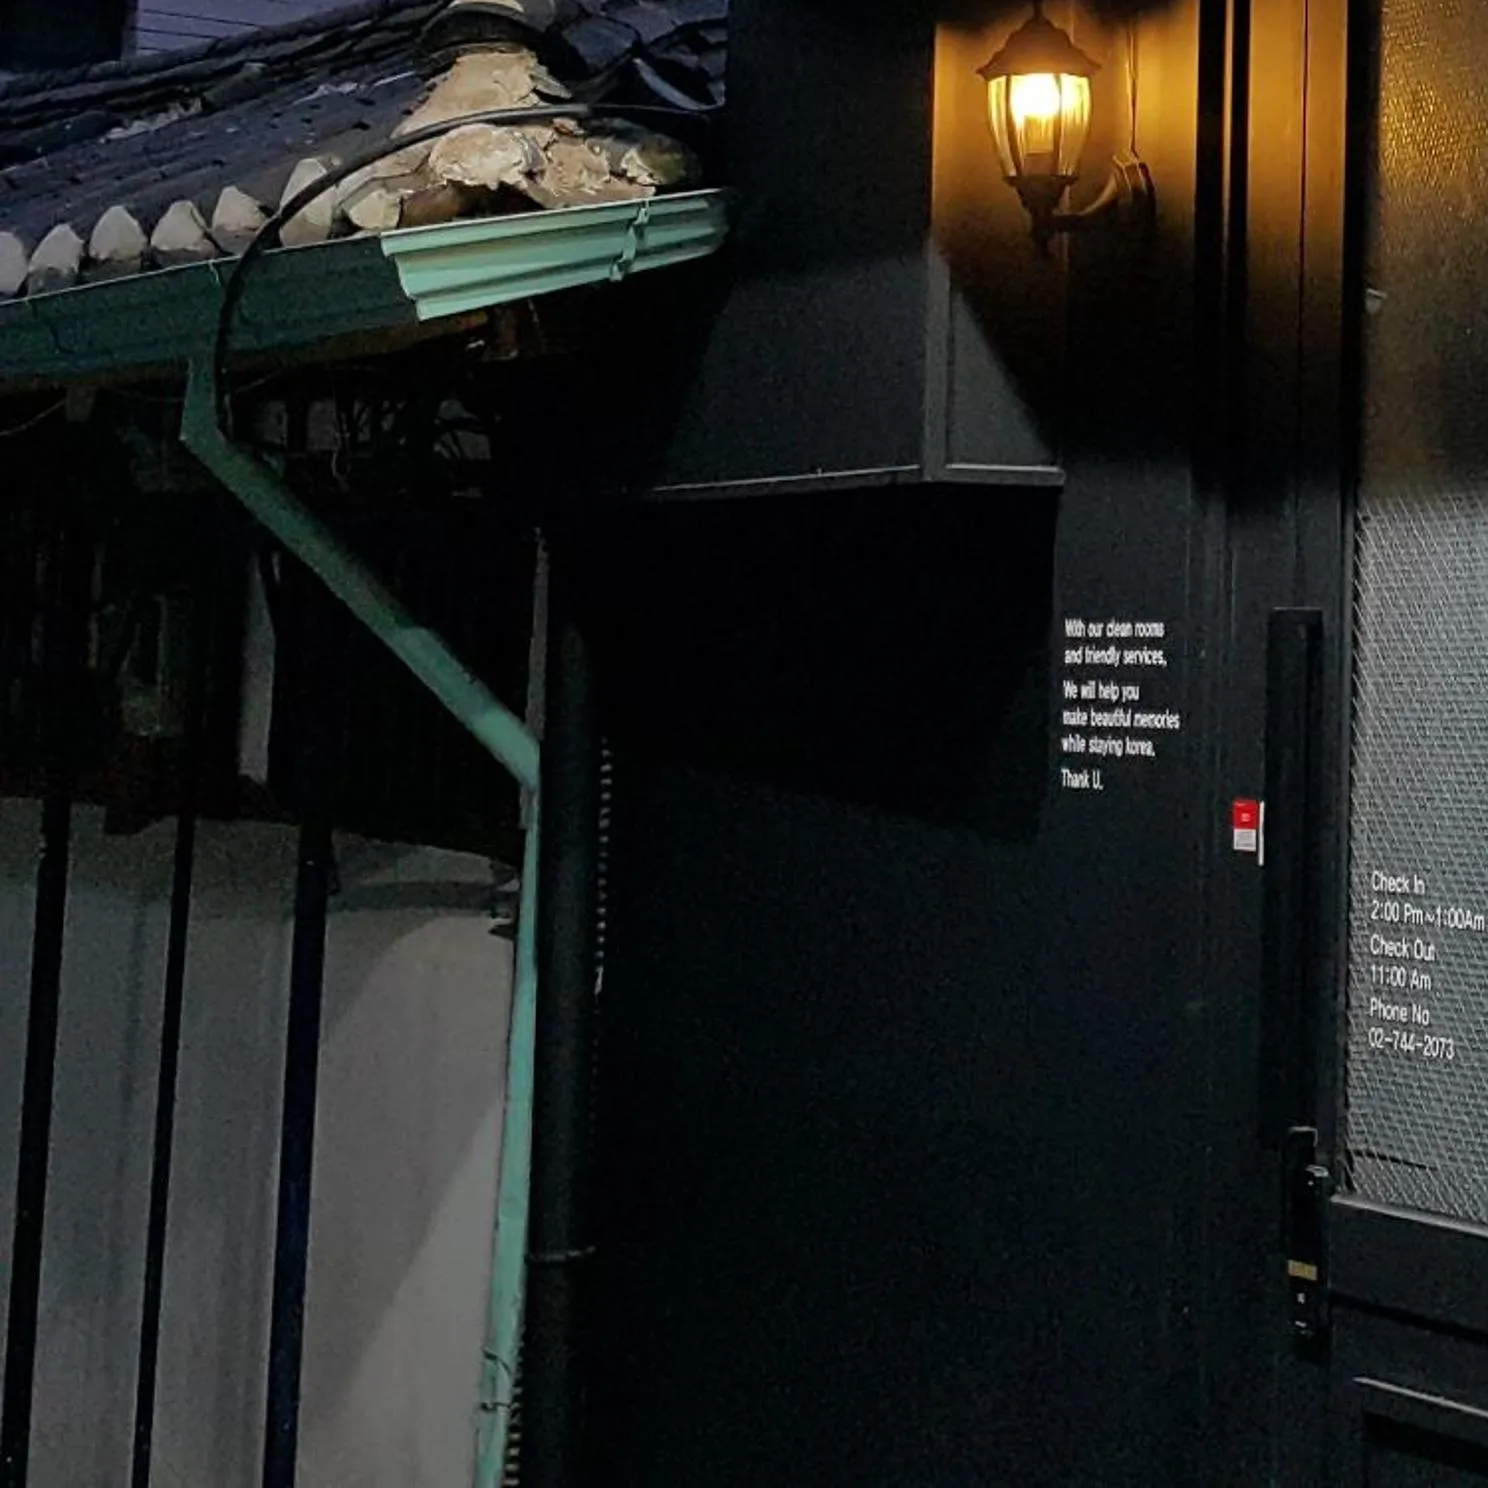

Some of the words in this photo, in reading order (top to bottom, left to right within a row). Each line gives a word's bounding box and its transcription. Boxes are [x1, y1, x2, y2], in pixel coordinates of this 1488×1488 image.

[1065, 618, 1086, 638] With
[1087, 622, 1104, 638] our
[1106, 617, 1133, 638] clean
[1135, 622, 1165, 638] rooms
[1065, 646, 1083, 664] and
[1085, 644, 1120, 668] friendly
[1063, 679, 1078, 700] We
[1080, 679, 1096, 699] will
[1098, 679, 1120, 703] help
[1121, 685, 1140, 703] you
[1063, 705, 1088, 726] make
[1090, 707, 1132, 727] beautiful
[1133, 707, 1180, 729] memories
[1061, 733, 1086, 753] while
[1089, 734, 1123, 757] staying
[1061, 768, 1090, 789] Thank
[1371, 870, 1410, 894] Check
[1414, 873, 1426, 895] In
[1371, 900, 1400, 922] 2:00
[1370, 933, 1410, 959] Check
[1413, 938, 1436, 962] Out
[1371, 964, 1407, 987] 11:00
[1410, 969, 1432, 991] Am
[1370, 997, 1408, 1023] Phone
[1412, 1004, 1430, 1026] No
